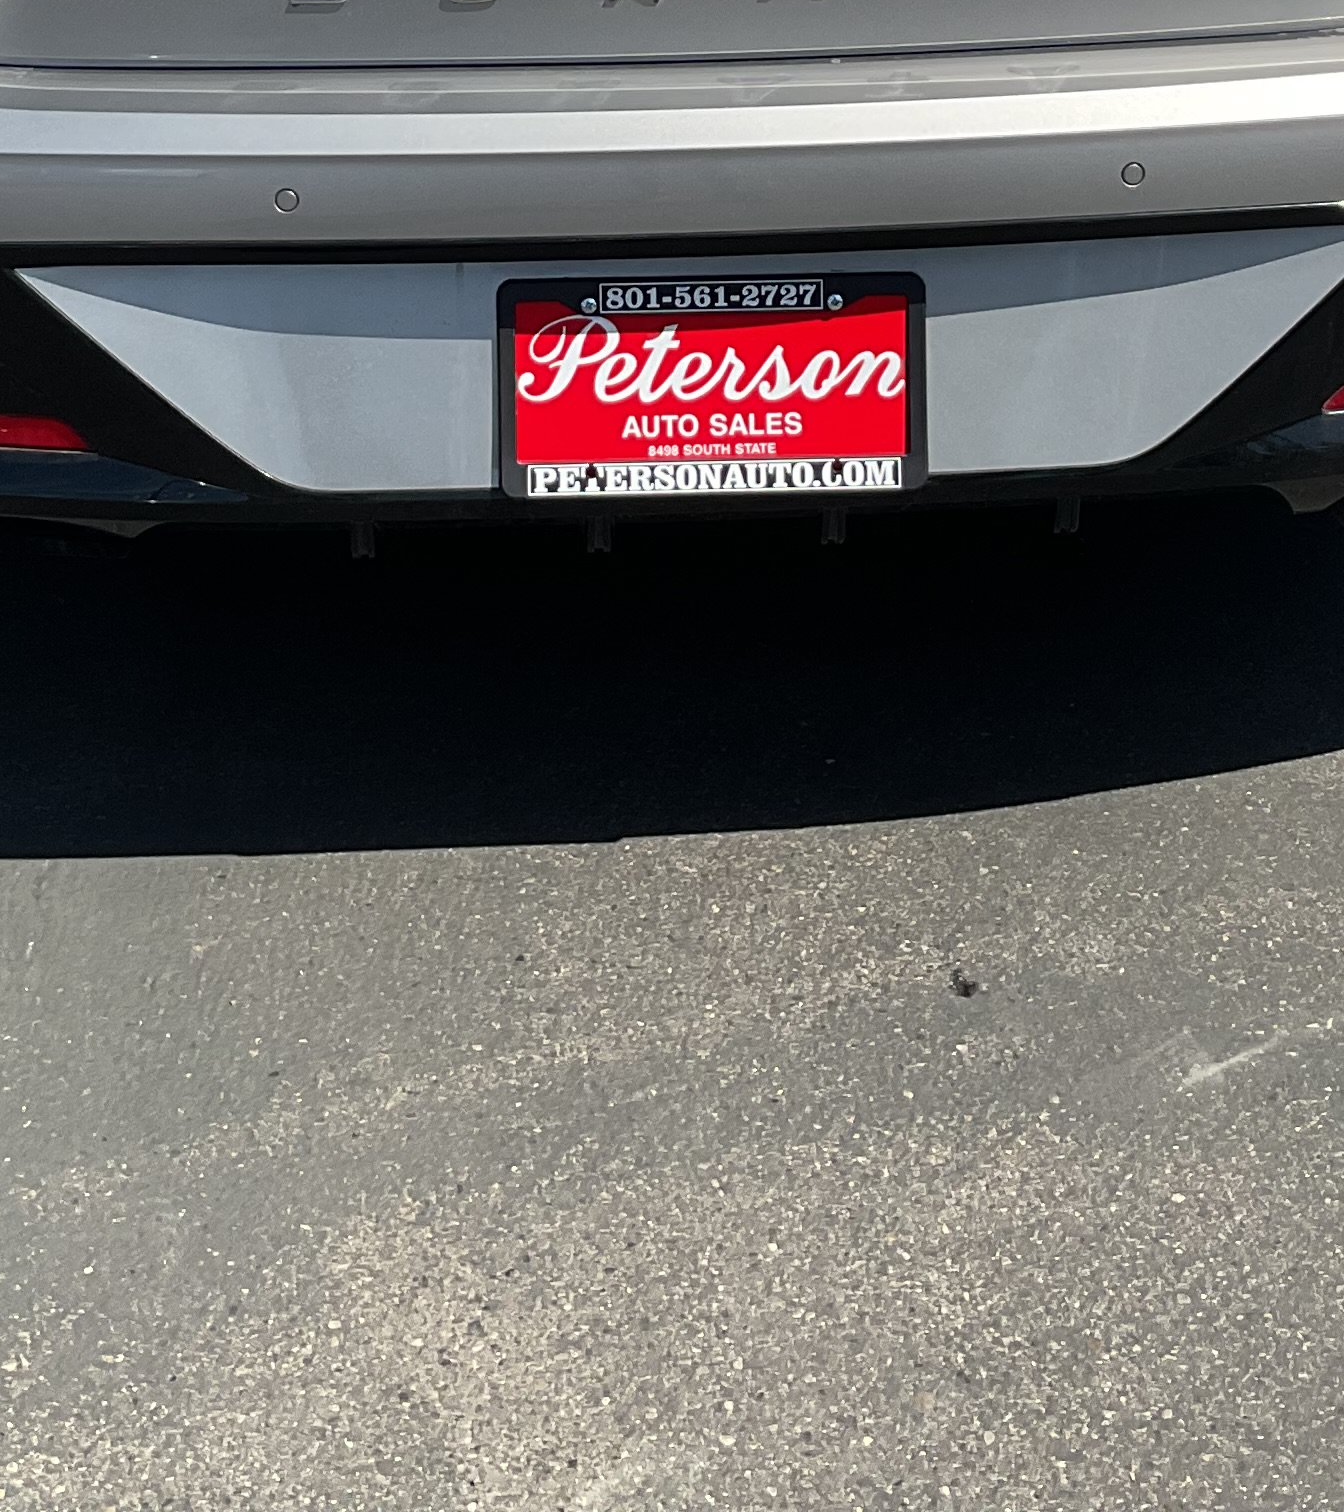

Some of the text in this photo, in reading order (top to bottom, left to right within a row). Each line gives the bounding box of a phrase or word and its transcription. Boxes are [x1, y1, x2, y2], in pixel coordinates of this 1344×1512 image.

[605, 283, 818, 310] 801-561-2727
[516, 315, 907, 405] Peterson
[621, 411, 804, 439] AUTO SALES
[647, 442, 777, 457] 8498 SOUTH STATE
